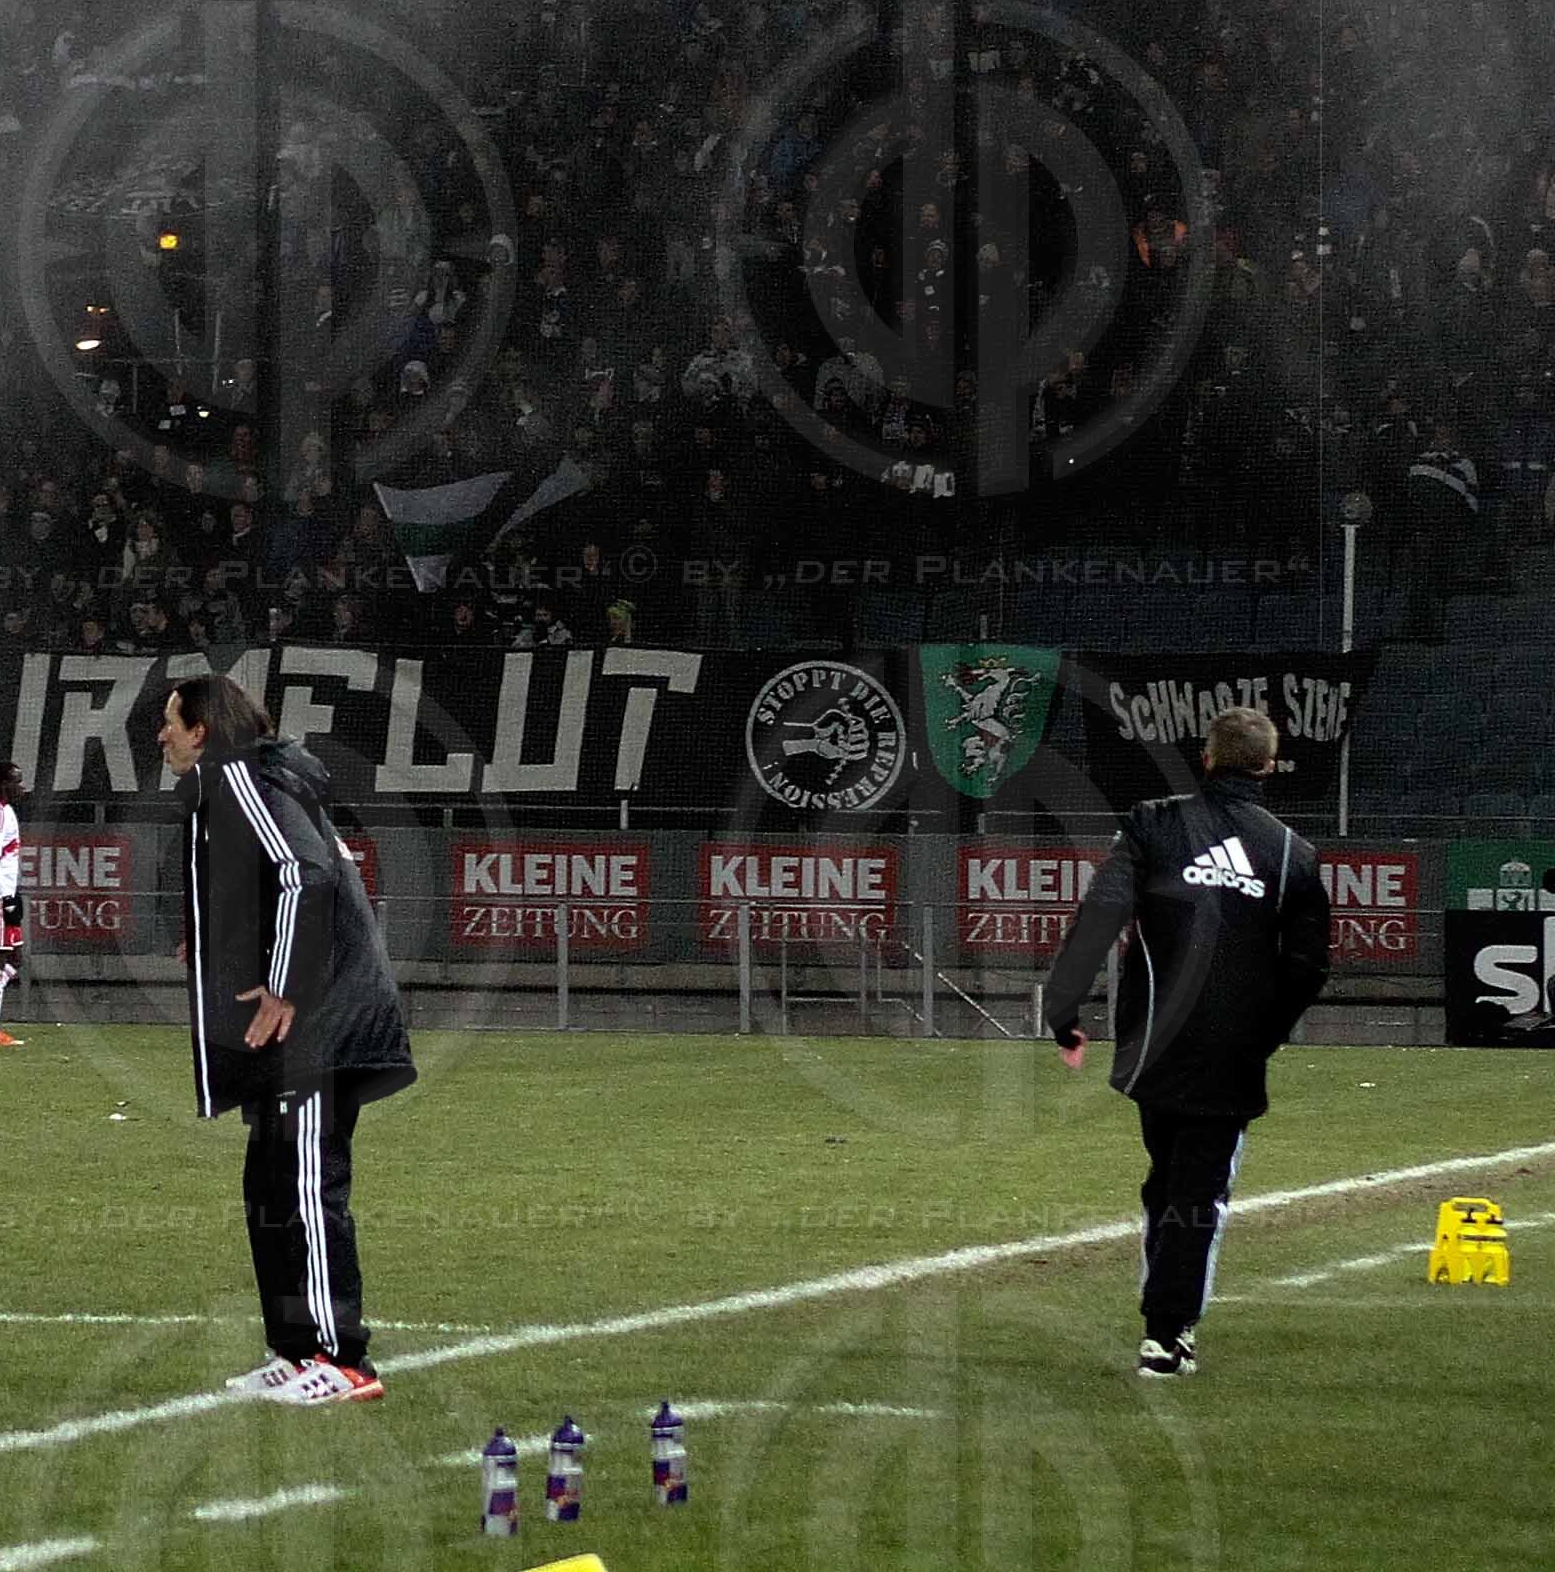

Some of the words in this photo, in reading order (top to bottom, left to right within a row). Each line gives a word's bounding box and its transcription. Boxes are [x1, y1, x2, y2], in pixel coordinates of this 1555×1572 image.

[756, 668, 848, 726] STOPPT
[849, 680, 892, 725] DIE
[463, 852, 639, 897] KLEINE
[709, 854, 887, 900] KLEINE
[967, 857, 1095, 902] KLEI
[1181, 862, 1267, 899] adidas
[1320, 863, 1408, 907] INE
[463, 907, 639, 940] ZEITUNG
[707, 909, 887, 943] ZEITUNG
[966, 912, 1070, 945] ZEIT
[1473, 916, 1555, 1015] s
